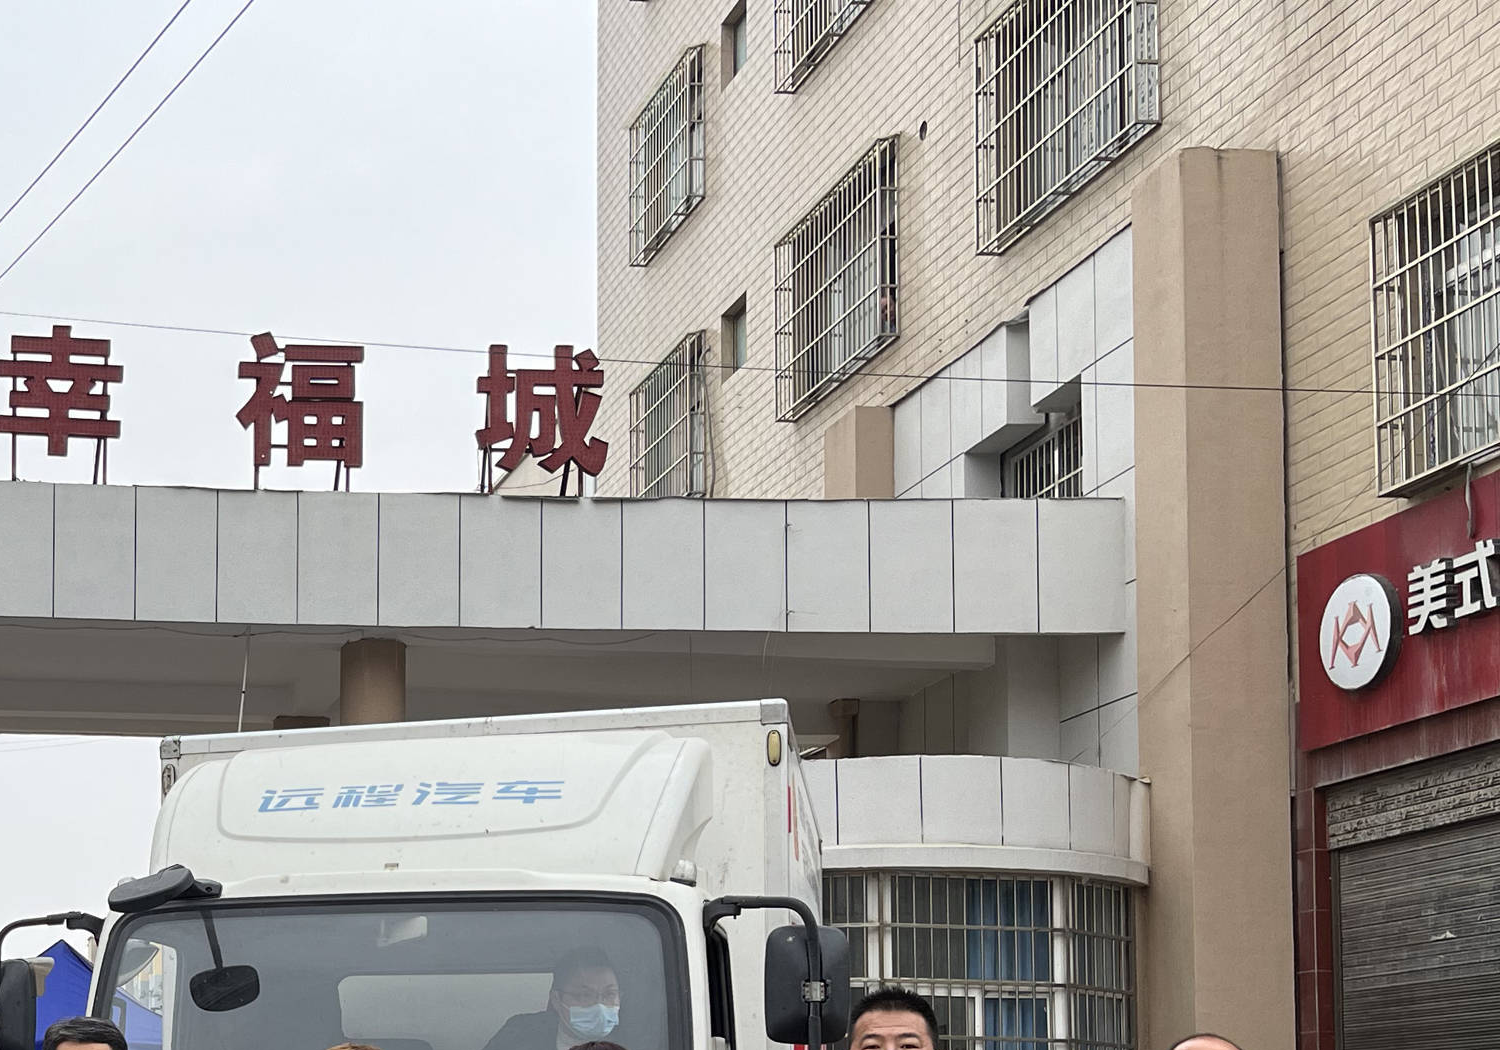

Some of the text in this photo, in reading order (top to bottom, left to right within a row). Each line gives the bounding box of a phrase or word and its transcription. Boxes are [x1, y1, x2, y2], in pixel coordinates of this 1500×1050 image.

[1407, 538, 1500, 636] 美式
[257, 780, 566, 813] 远程汽车
